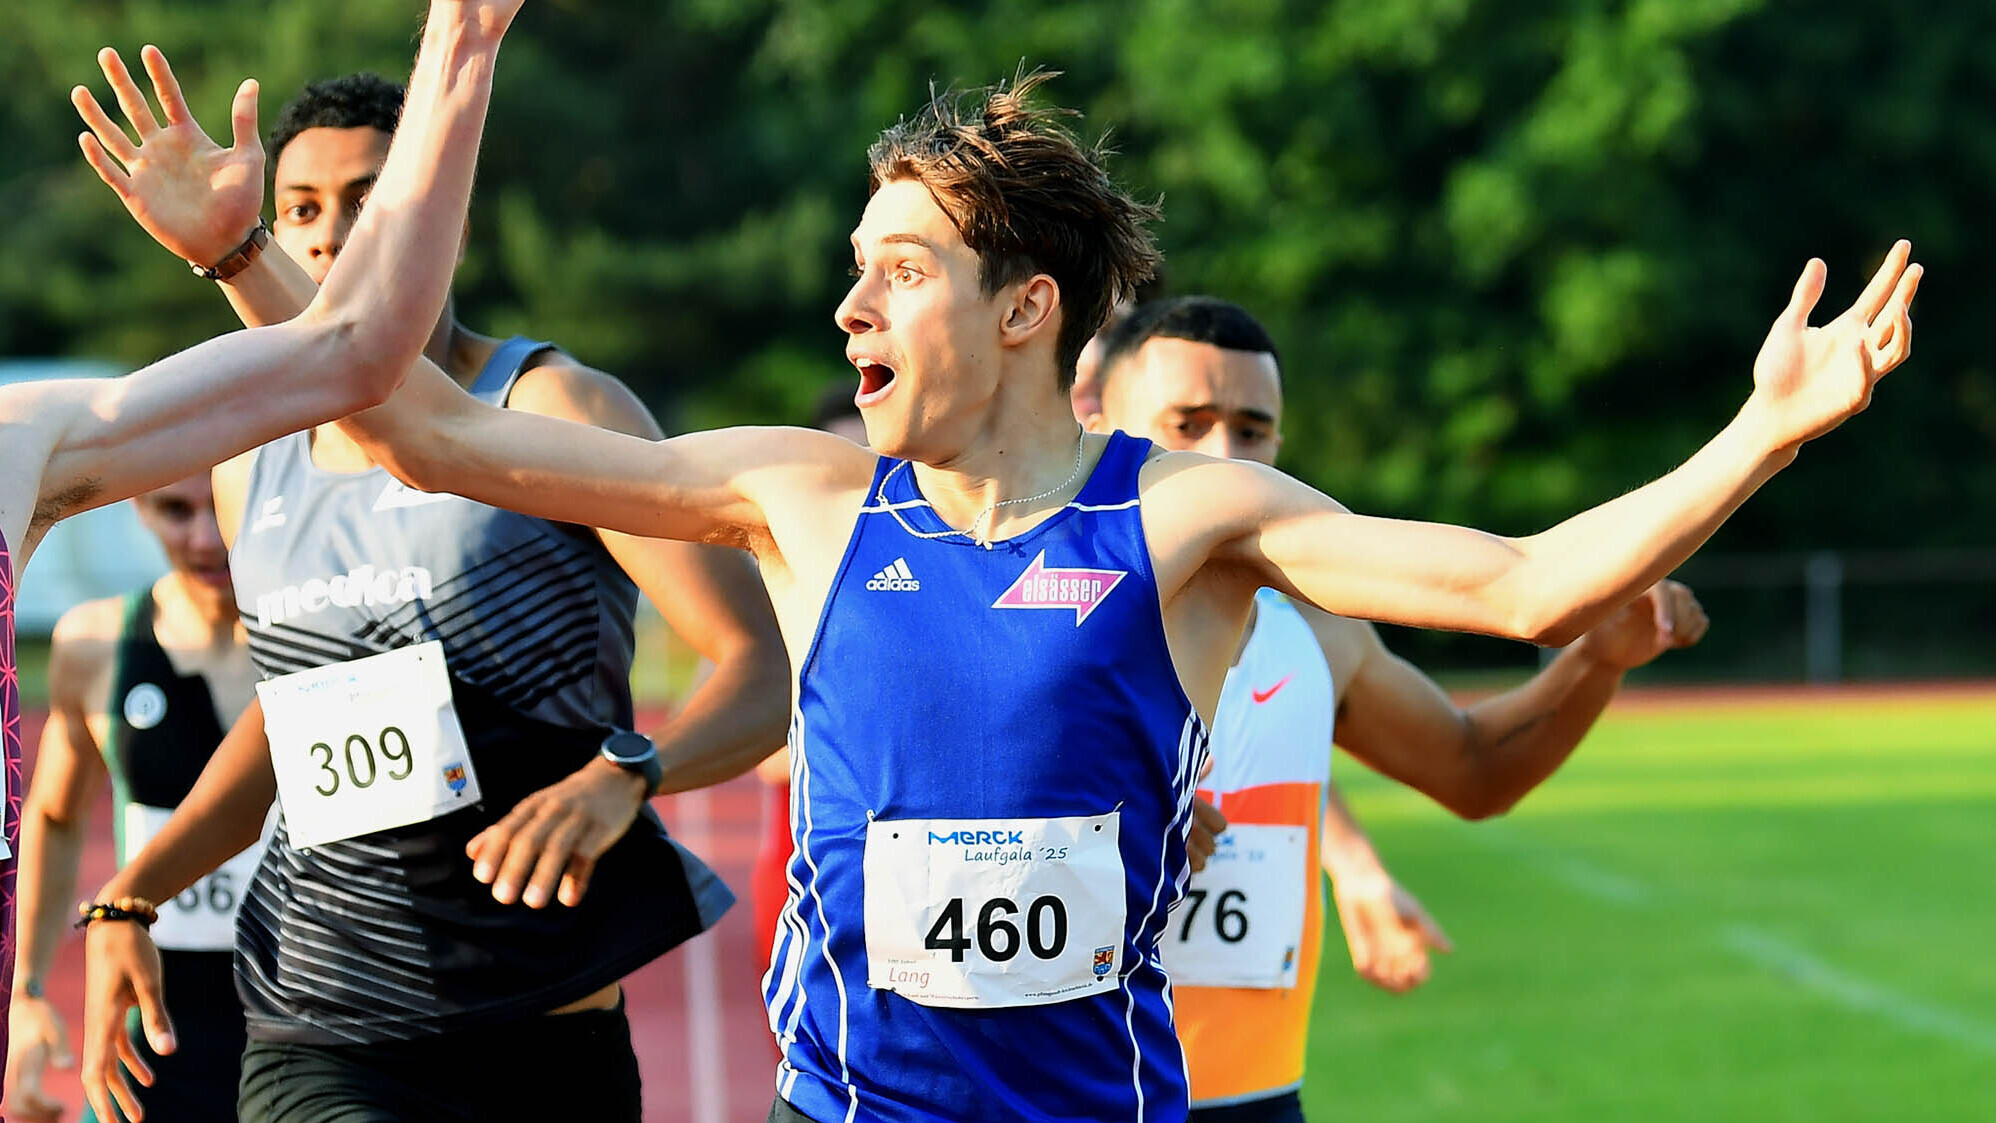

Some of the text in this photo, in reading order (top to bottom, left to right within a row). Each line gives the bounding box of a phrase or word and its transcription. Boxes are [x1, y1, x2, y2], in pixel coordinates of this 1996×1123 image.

[865, 577, 920, 592] adidas
[1022, 573, 1102, 603] elsässer
[310, 726, 413, 797] 309
[965, 847, 1032, 865] Laufgala
[924, 895, 1068, 963] 460
[1179, 889, 1249, 943] 76
[888, 967, 930, 987] Lang
